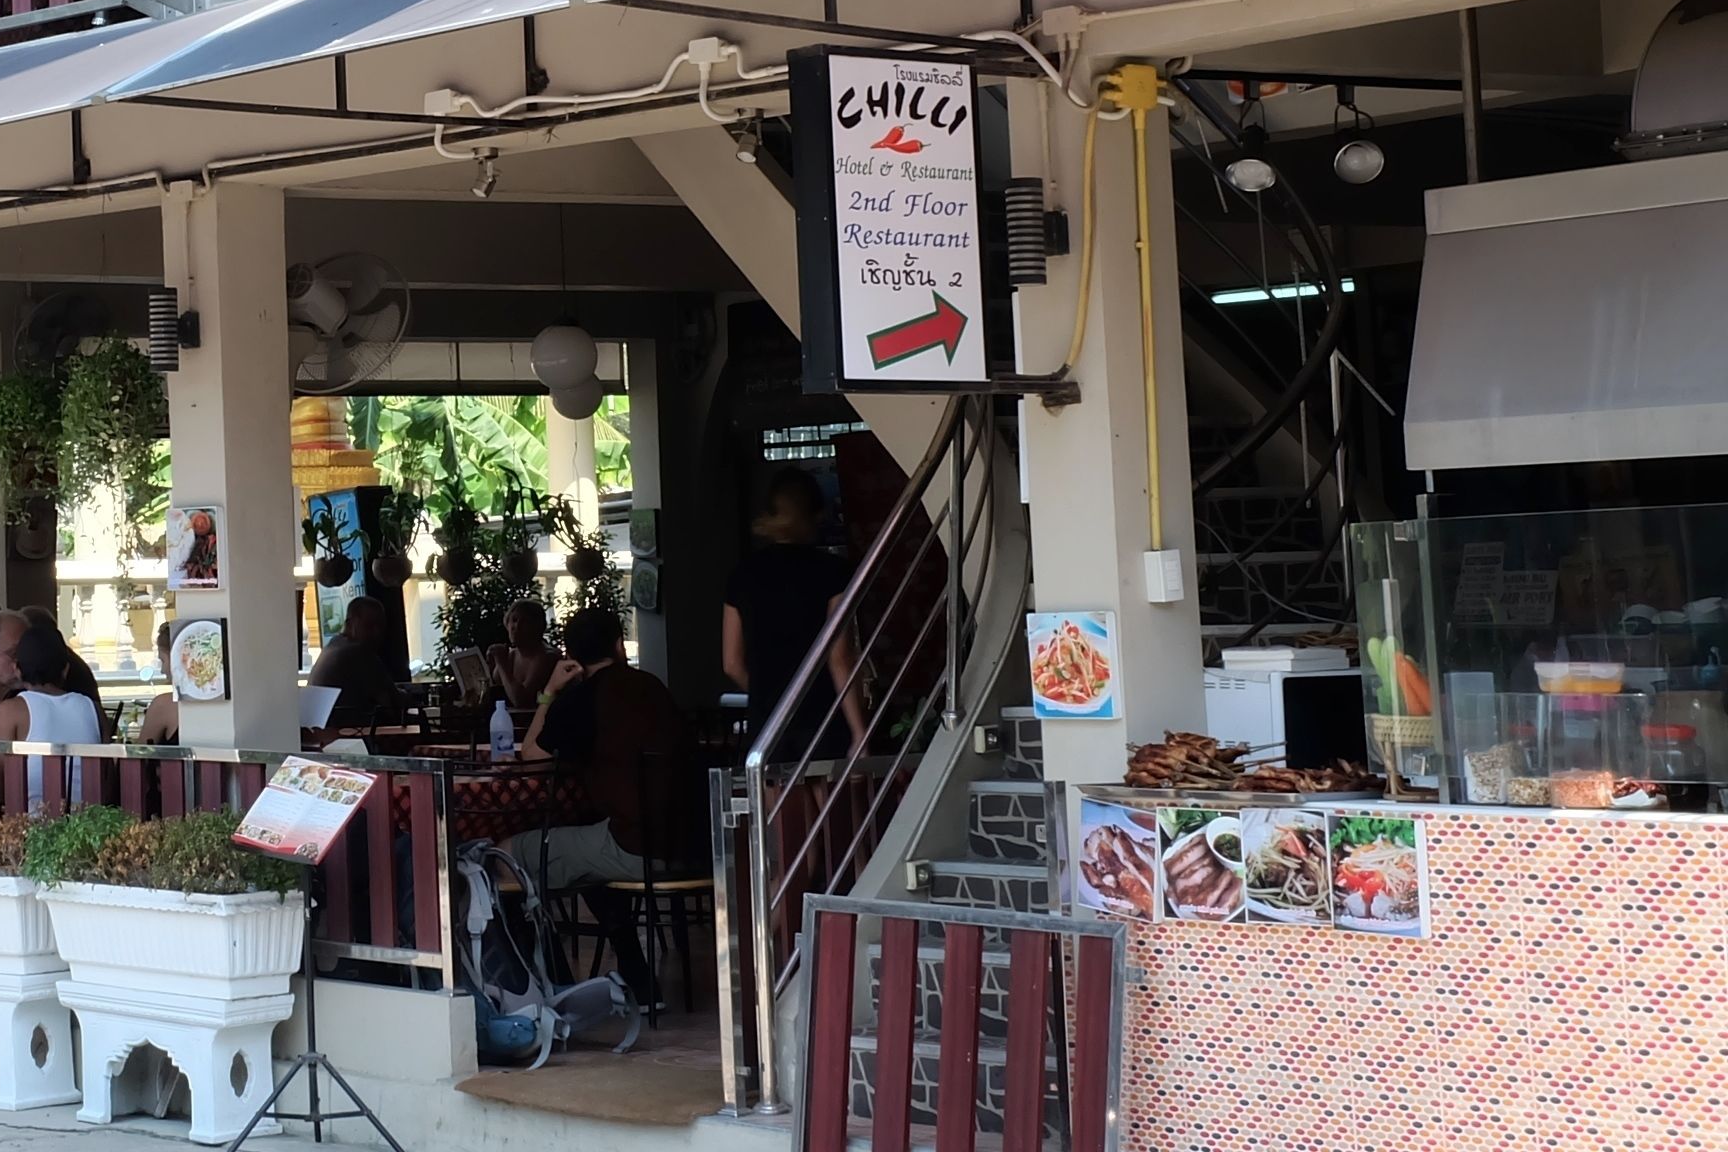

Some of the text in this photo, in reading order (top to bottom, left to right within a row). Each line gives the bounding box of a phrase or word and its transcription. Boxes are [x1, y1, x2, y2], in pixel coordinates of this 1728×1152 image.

[837, 81, 967, 136] CHILLI
[835, 155, 974, 183] Hotel & Restaurant
[848, 189, 969, 218] 2nd Floor
[843, 223, 971, 249] Restaurant
[861, 252, 963, 291] เชิญชั้น 2
